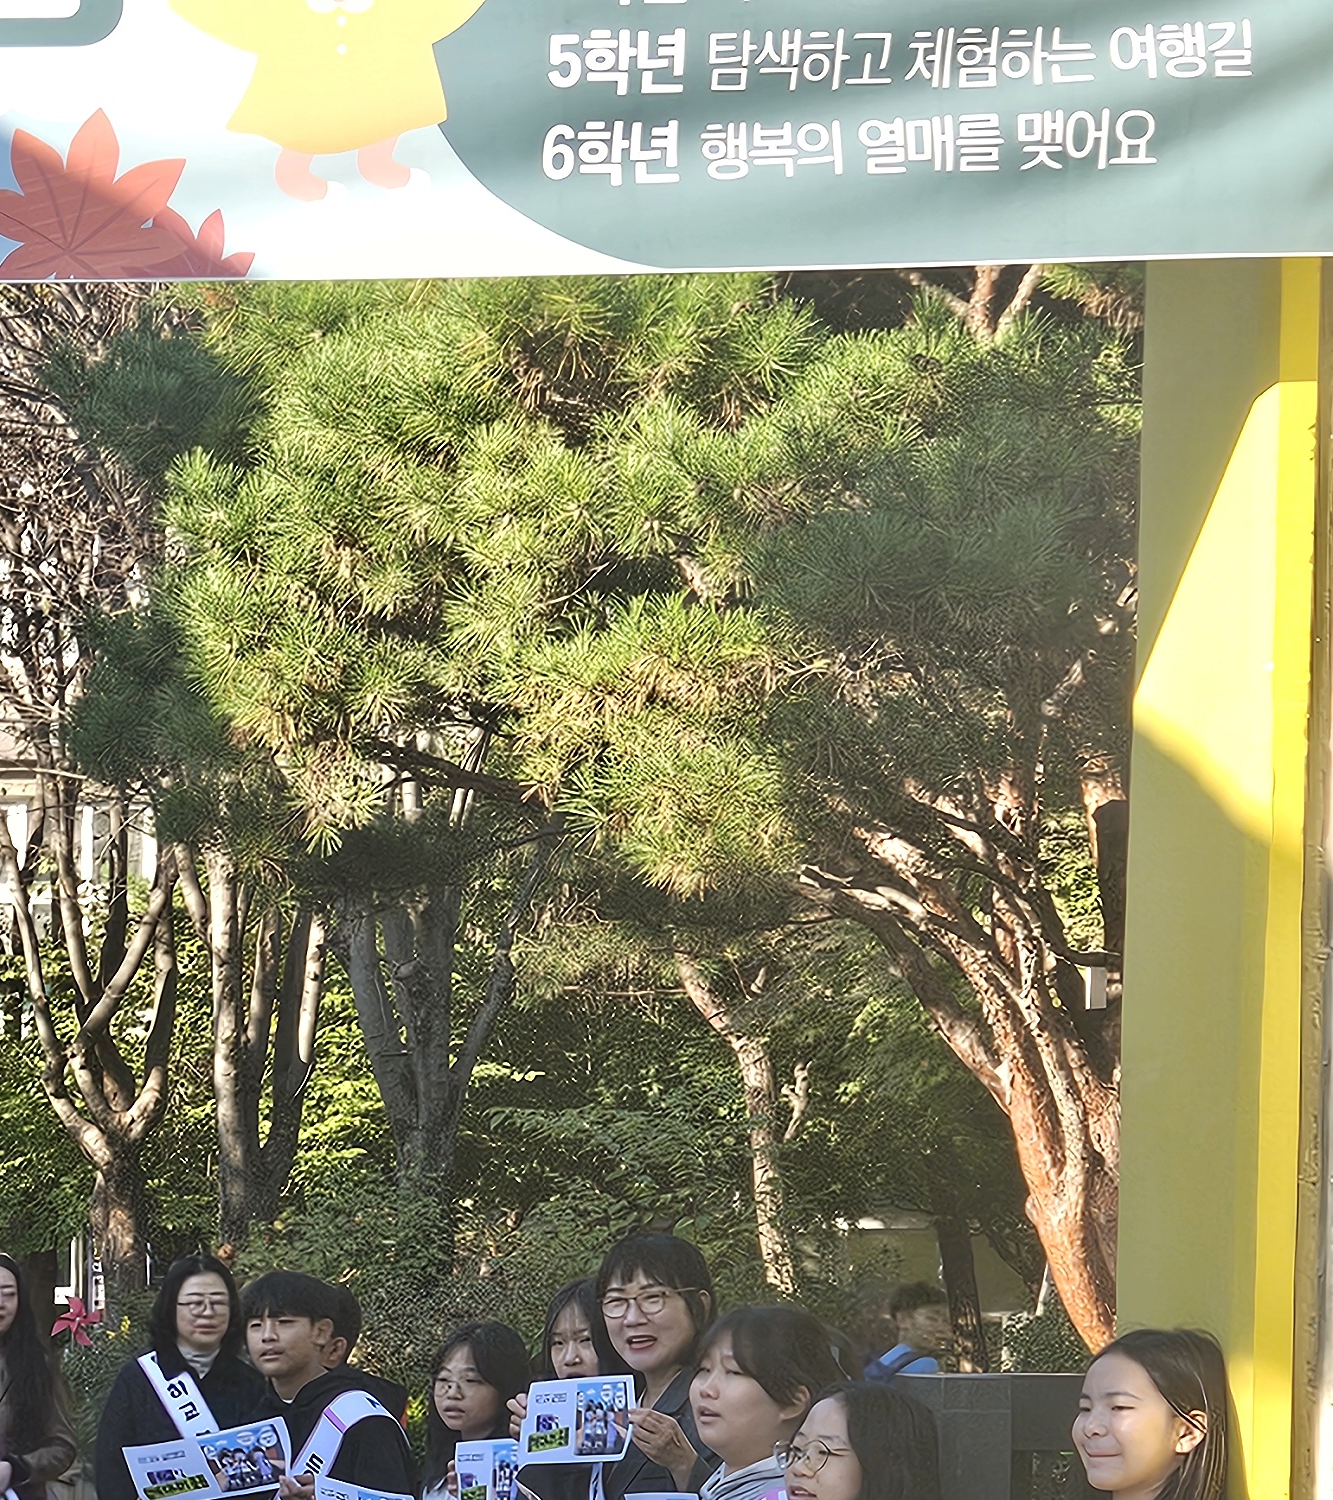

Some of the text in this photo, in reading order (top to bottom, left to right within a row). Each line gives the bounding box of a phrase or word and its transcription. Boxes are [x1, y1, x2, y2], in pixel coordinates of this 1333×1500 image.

[547, 18, 1253, 96] 5학년 탐색하고 체험하는 여행길
[541, 107, 1158, 187] 6학년 행복의 열매를 맺어요
